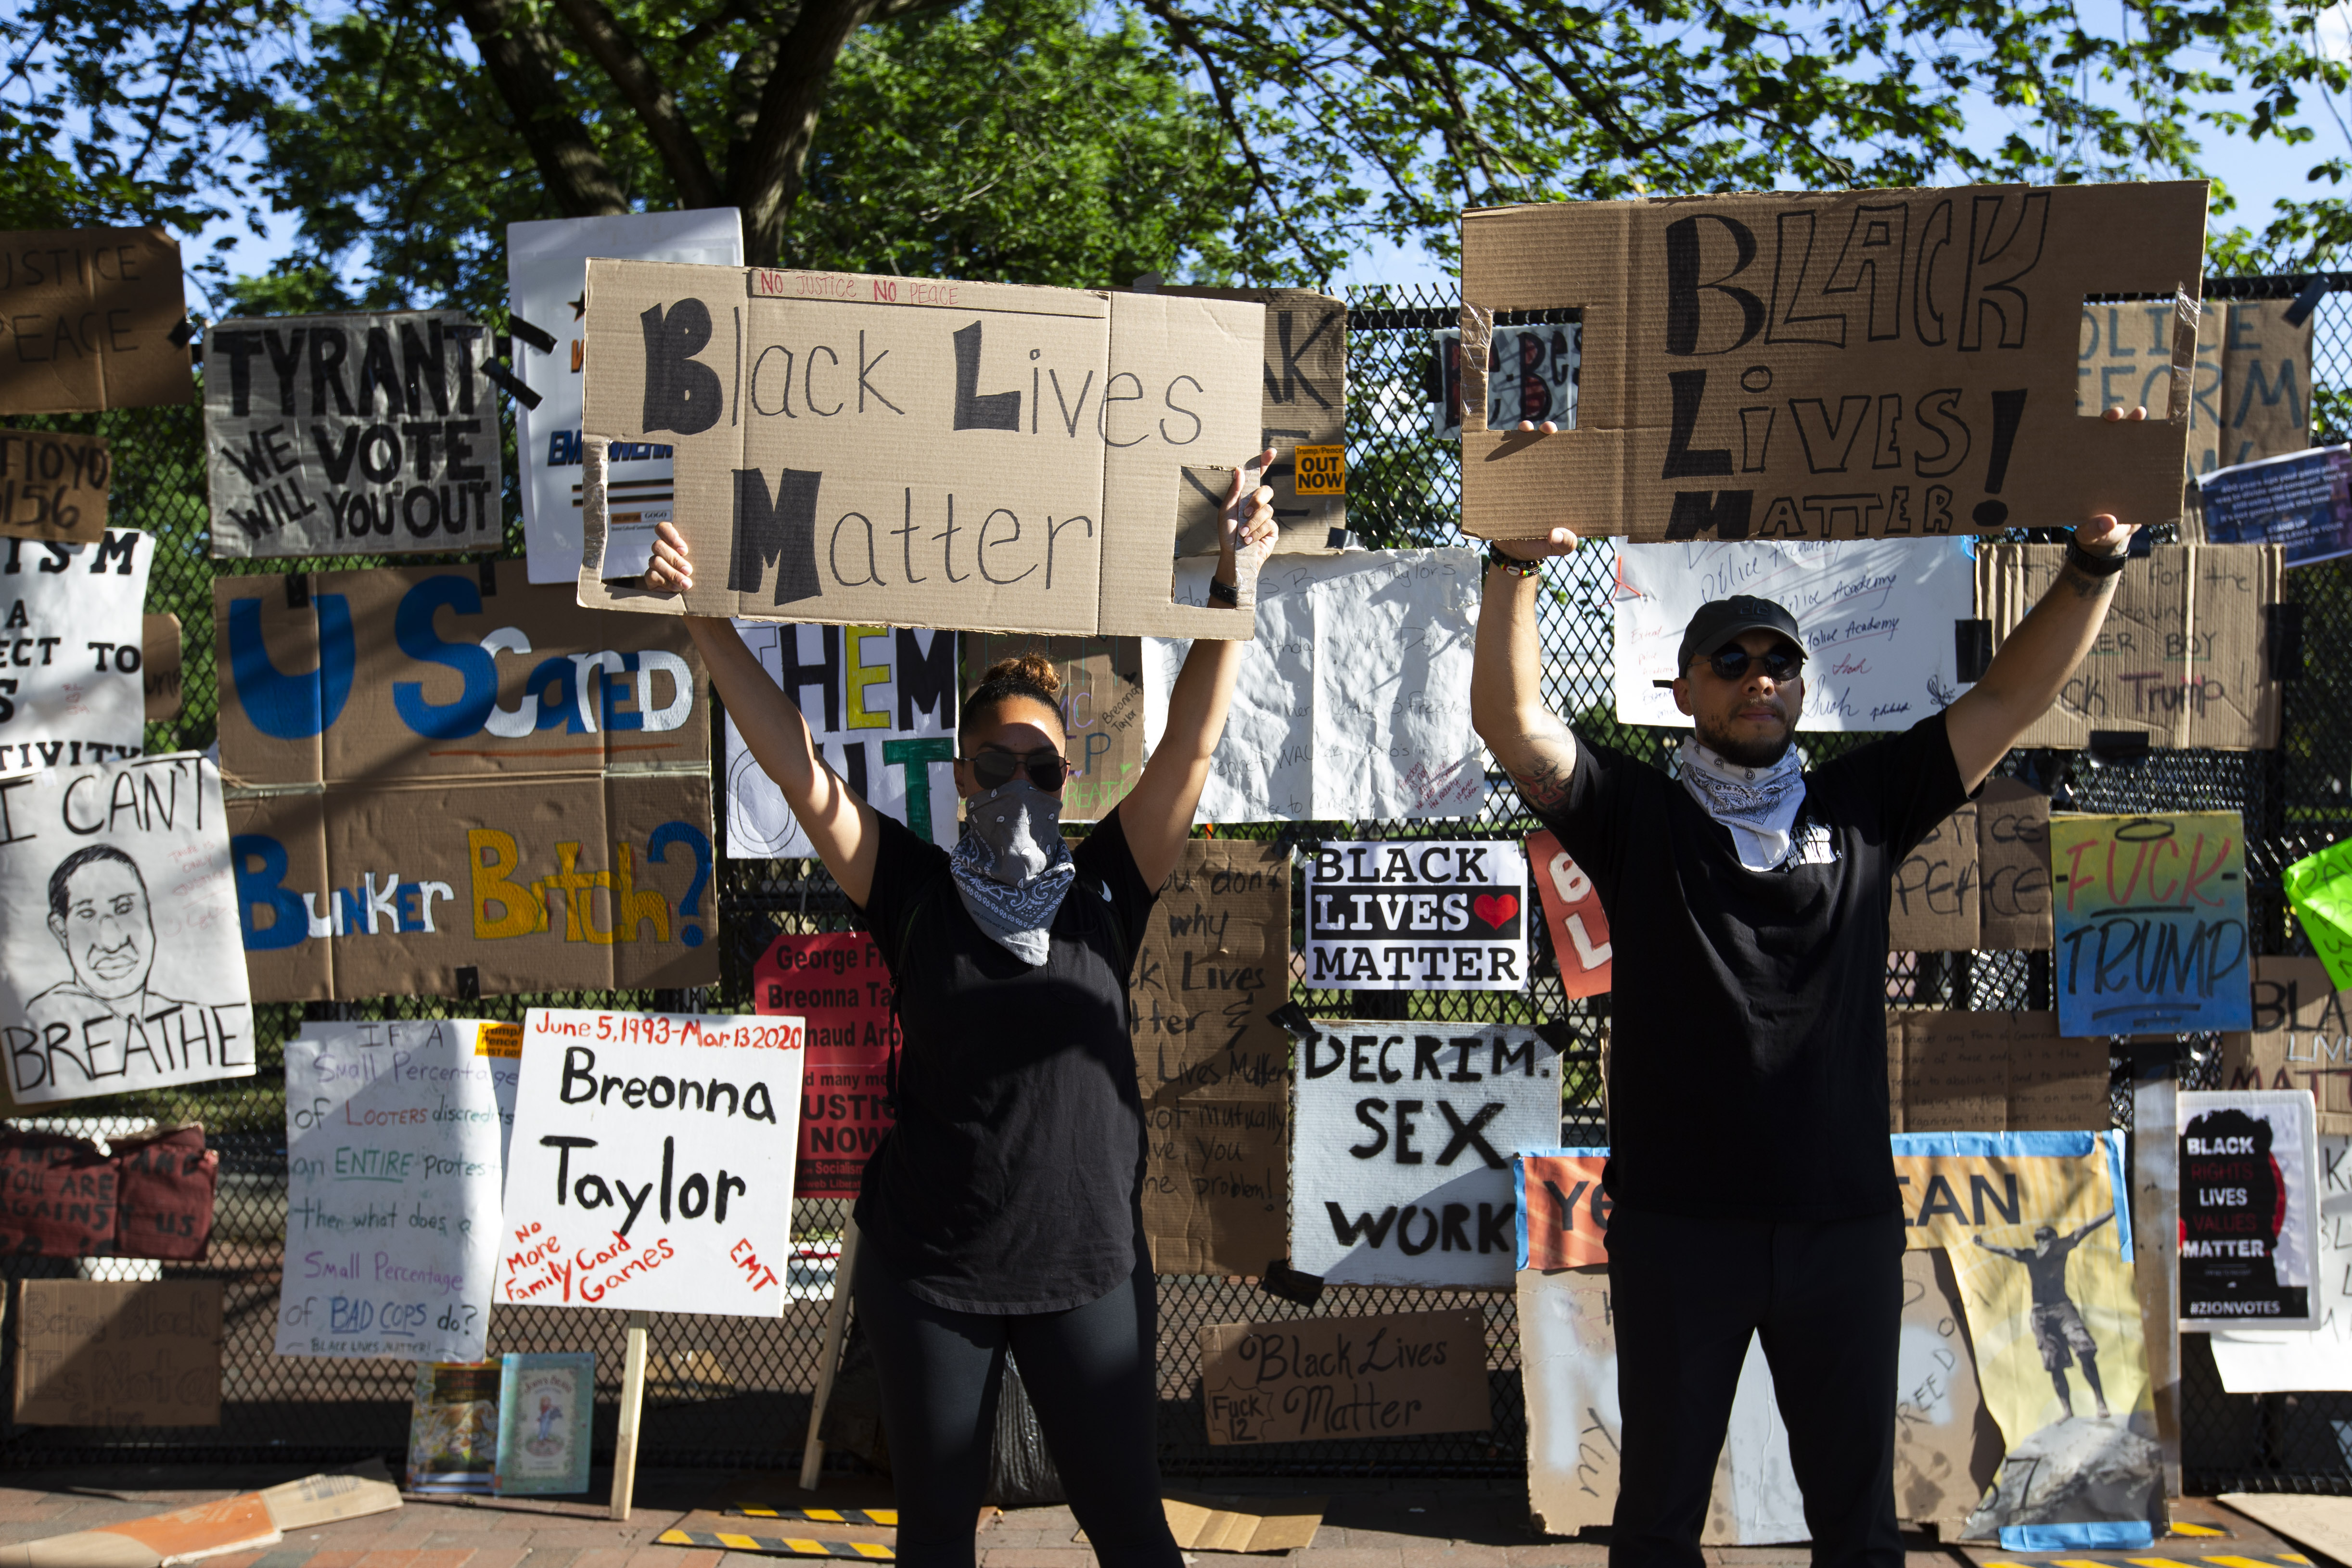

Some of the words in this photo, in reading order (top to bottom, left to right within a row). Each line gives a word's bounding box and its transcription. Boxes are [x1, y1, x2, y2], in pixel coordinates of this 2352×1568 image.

[761, 271, 783, 294] NO
[796, 275, 856, 297] JUSTiCe
[873, 279, 896, 302] NO
[910, 282, 959, 306] PEaCE
[1664, 191, 2051, 356] BLACK
[0, 308, 140, 363] EACE
[214, 319, 483, 420] TYRANT
[641, 297, 905, 435] Black
[953, 320, 1203, 446] Lives
[222, 424, 300, 485] WE
[311, 420, 485, 484] VOTE
[1301, 457, 1339, 472] OUT
[1662, 364, 2028, 527] LiVES!
[1298, 472, 1343, 488] NOW
[226, 476, 317, 540] WILL
[324, 487, 395, 539] YOU
[403, 482, 491, 539] OUT
[1664, 485, 1953, 540] MATTER
[2267, 522, 2295, 534] STAND
[2295, 518, 2308, 529] UP
[728, 468, 1092, 607] Matter
[9, 599, 29, 630] A
[88, 641, 141, 674] TO
[2165, 631, 2216, 661] BOY
[229, 593, 356, 741] U
[1101, 686, 1144, 725] Breonna
[0, 780, 37, 845] I
[63, 755, 208, 835] CAN'T
[1211, 861, 1282, 895] don't
[1312, 847, 1489, 884] BLACK
[1895, 854, 2051, 930] PEACE
[1169, 903, 1230, 952] why
[1315, 893, 1470, 932] LIVES
[776, 944, 858, 975] George
[1181, 950, 1266, 991] Lives
[1312, 946, 1520, 982] MATTER
[2061, 917, 2248, 997] TRUMP
[767, 983, 859, 1009] Breonna
[356, 1023, 403, 1048] IF
[426, 1022, 444, 1048] A
[536, 1011, 591, 1037] June
[752, 1024, 803, 1050] 2020
[1131, 999, 1214, 1035] tter
[4, 1003, 256, 1093] BREATHE
[481, 1036, 518, 1047] Pence
[1304, 1032, 1550, 1084] DECRIM.
[313, 1053, 378, 1084] Small
[392, 1050, 518, 1086] Percentage
[820, 1072, 859, 1091] many
[1157, 1041, 1222, 1086] Lives
[559, 1046, 777, 1125] Breonna
[345, 1099, 427, 1127] LOOTERS
[432, 1094, 515, 1126] discredits
[1349, 1097, 1508, 1169] SEX
[2186, 1136, 2254, 1155] BLACK
[292, 1157, 325, 1179] an
[334, 1147, 413, 1177] ENTIRE
[2191, 1162, 2254, 1182] RIGHTS
[59, 1173, 115, 1201] ARE
[539, 1135, 746, 1237] Taylor
[1192, 1167, 1275, 1212] problem!
[1895, 1173, 2021, 1227] AN
[2199, 1188, 2248, 1207] LIVES
[294, 1197, 345, 1230] then
[352, 1204, 397, 1229] what
[458, 1220, 472, 1233] a
[515, 1221, 542, 1244] No
[1324, 1201, 1517, 1256] WORK
[2193, 1214, 2257, 1233] VALUES
[304, 1250, 360, 1281] Small
[374, 1251, 464, 1296] Percentage
[504, 1258, 572, 1303] Family
[576, 1230, 631, 1271] Card
[506, 1236, 561, 1275] More
[579, 1237, 674, 1303] Games
[729, 1237, 779, 1293] EMT
[330, 1294, 375, 1331] BAD
[380, 1302, 428, 1333] COPS
[437, 1304, 479, 1336] do?
[2190, 1300, 2281, 1315] #ZIONVOTES
[1239, 1333, 1353, 1385] Black
[1357, 1326, 1447, 1375] Lives
[1212, 1394, 1265, 1420] Fuck
[1282, 1381, 1422, 1435] Matter
[1229, 1418, 1258, 1442] 12
